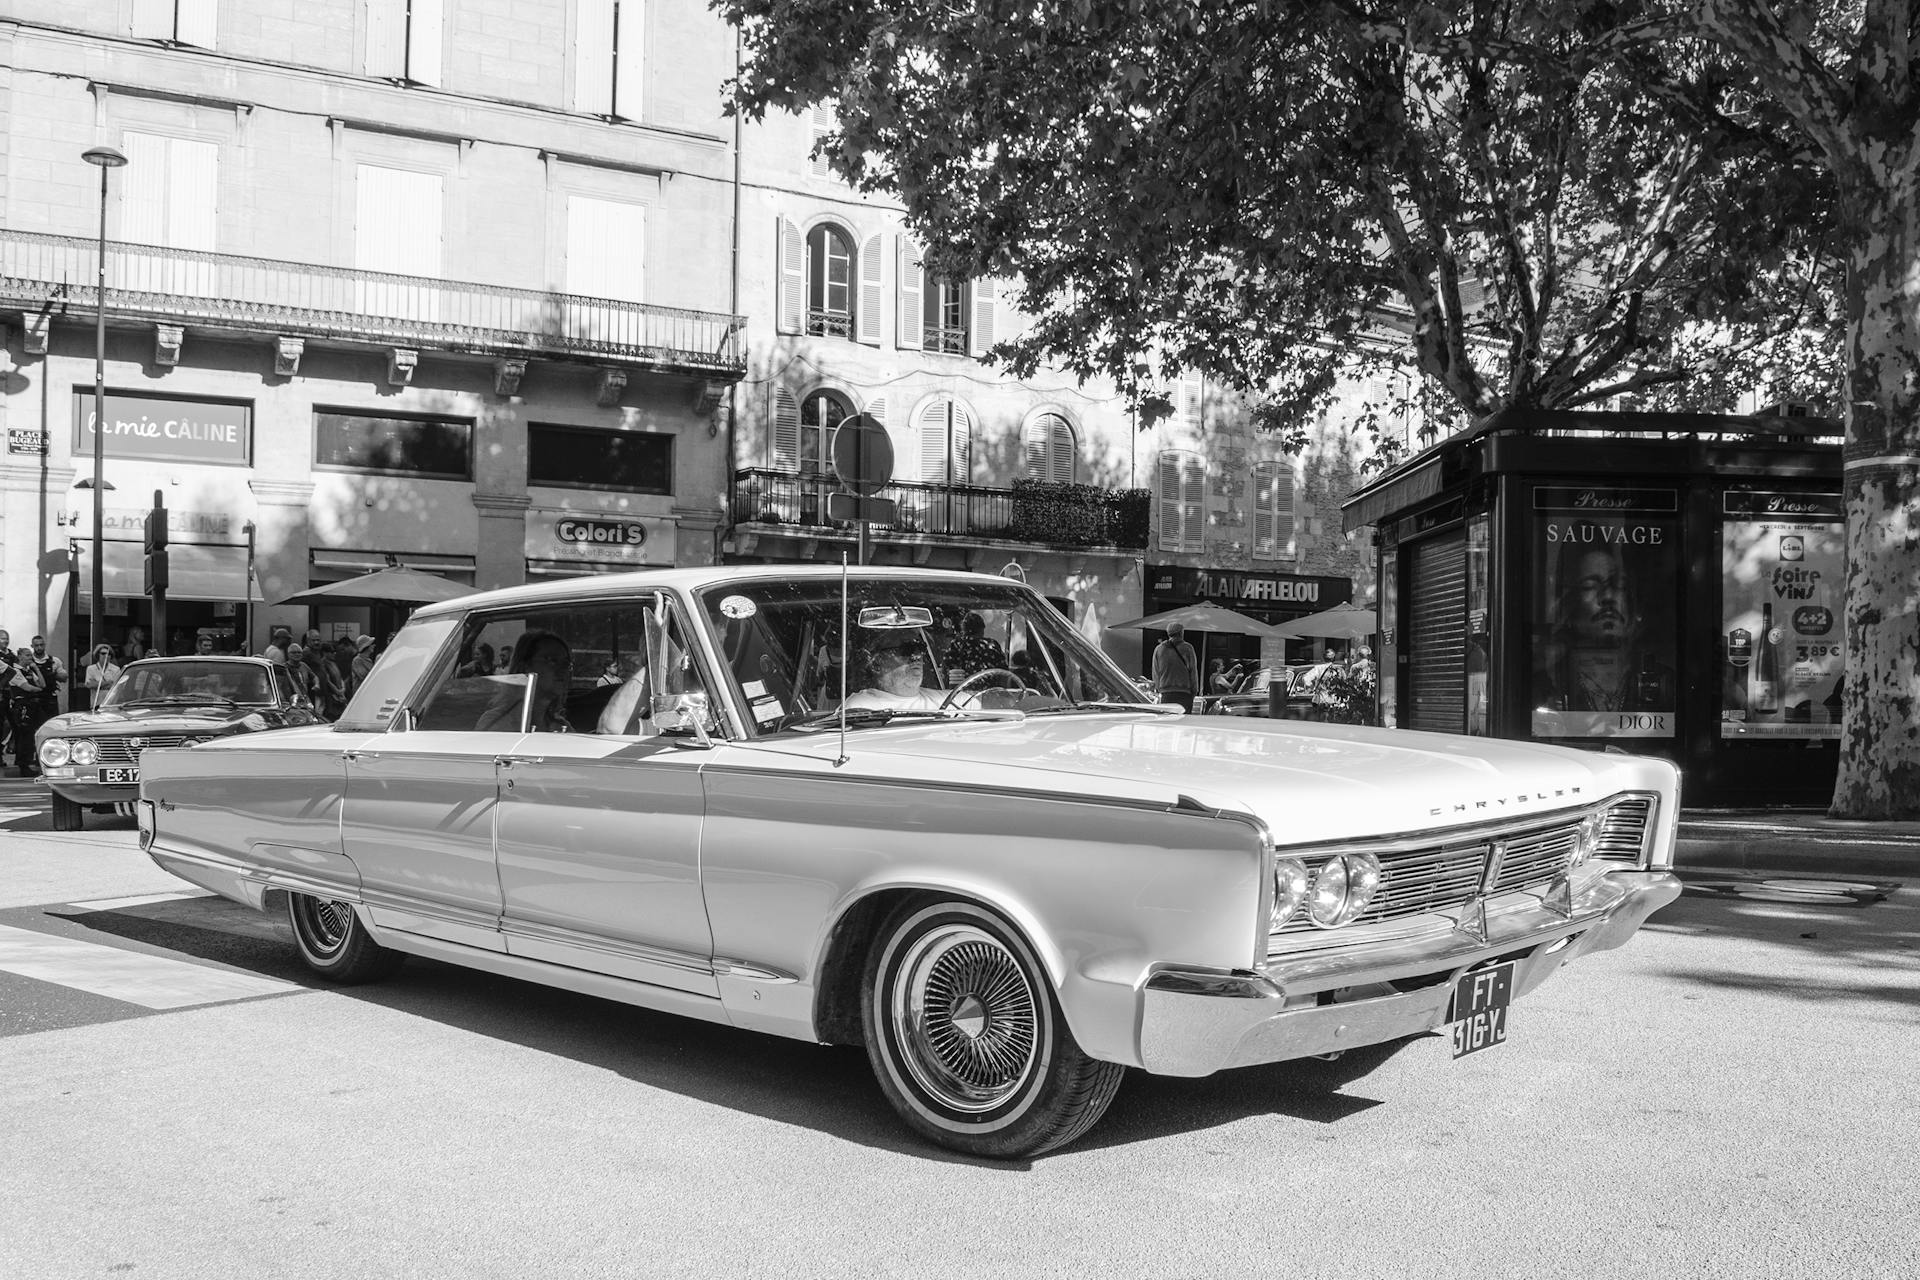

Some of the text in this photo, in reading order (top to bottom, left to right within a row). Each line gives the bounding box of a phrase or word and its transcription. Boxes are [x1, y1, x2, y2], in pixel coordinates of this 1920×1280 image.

[115, 416, 161, 438] mie
[164, 418, 237, 443] CÂLINE
[1767, 496, 1818, 512] Presse
[1547, 524, 1662, 545] SAUVAGE
[1195, 573, 1246, 598] ALAIN
[1242, 579, 1319, 602] AFFLELOU
[1797, 612, 1828, 625] 4+2
[1618, 715, 1665, 730] DIOR
[1430, 787, 1580, 815] CHRYSLER
